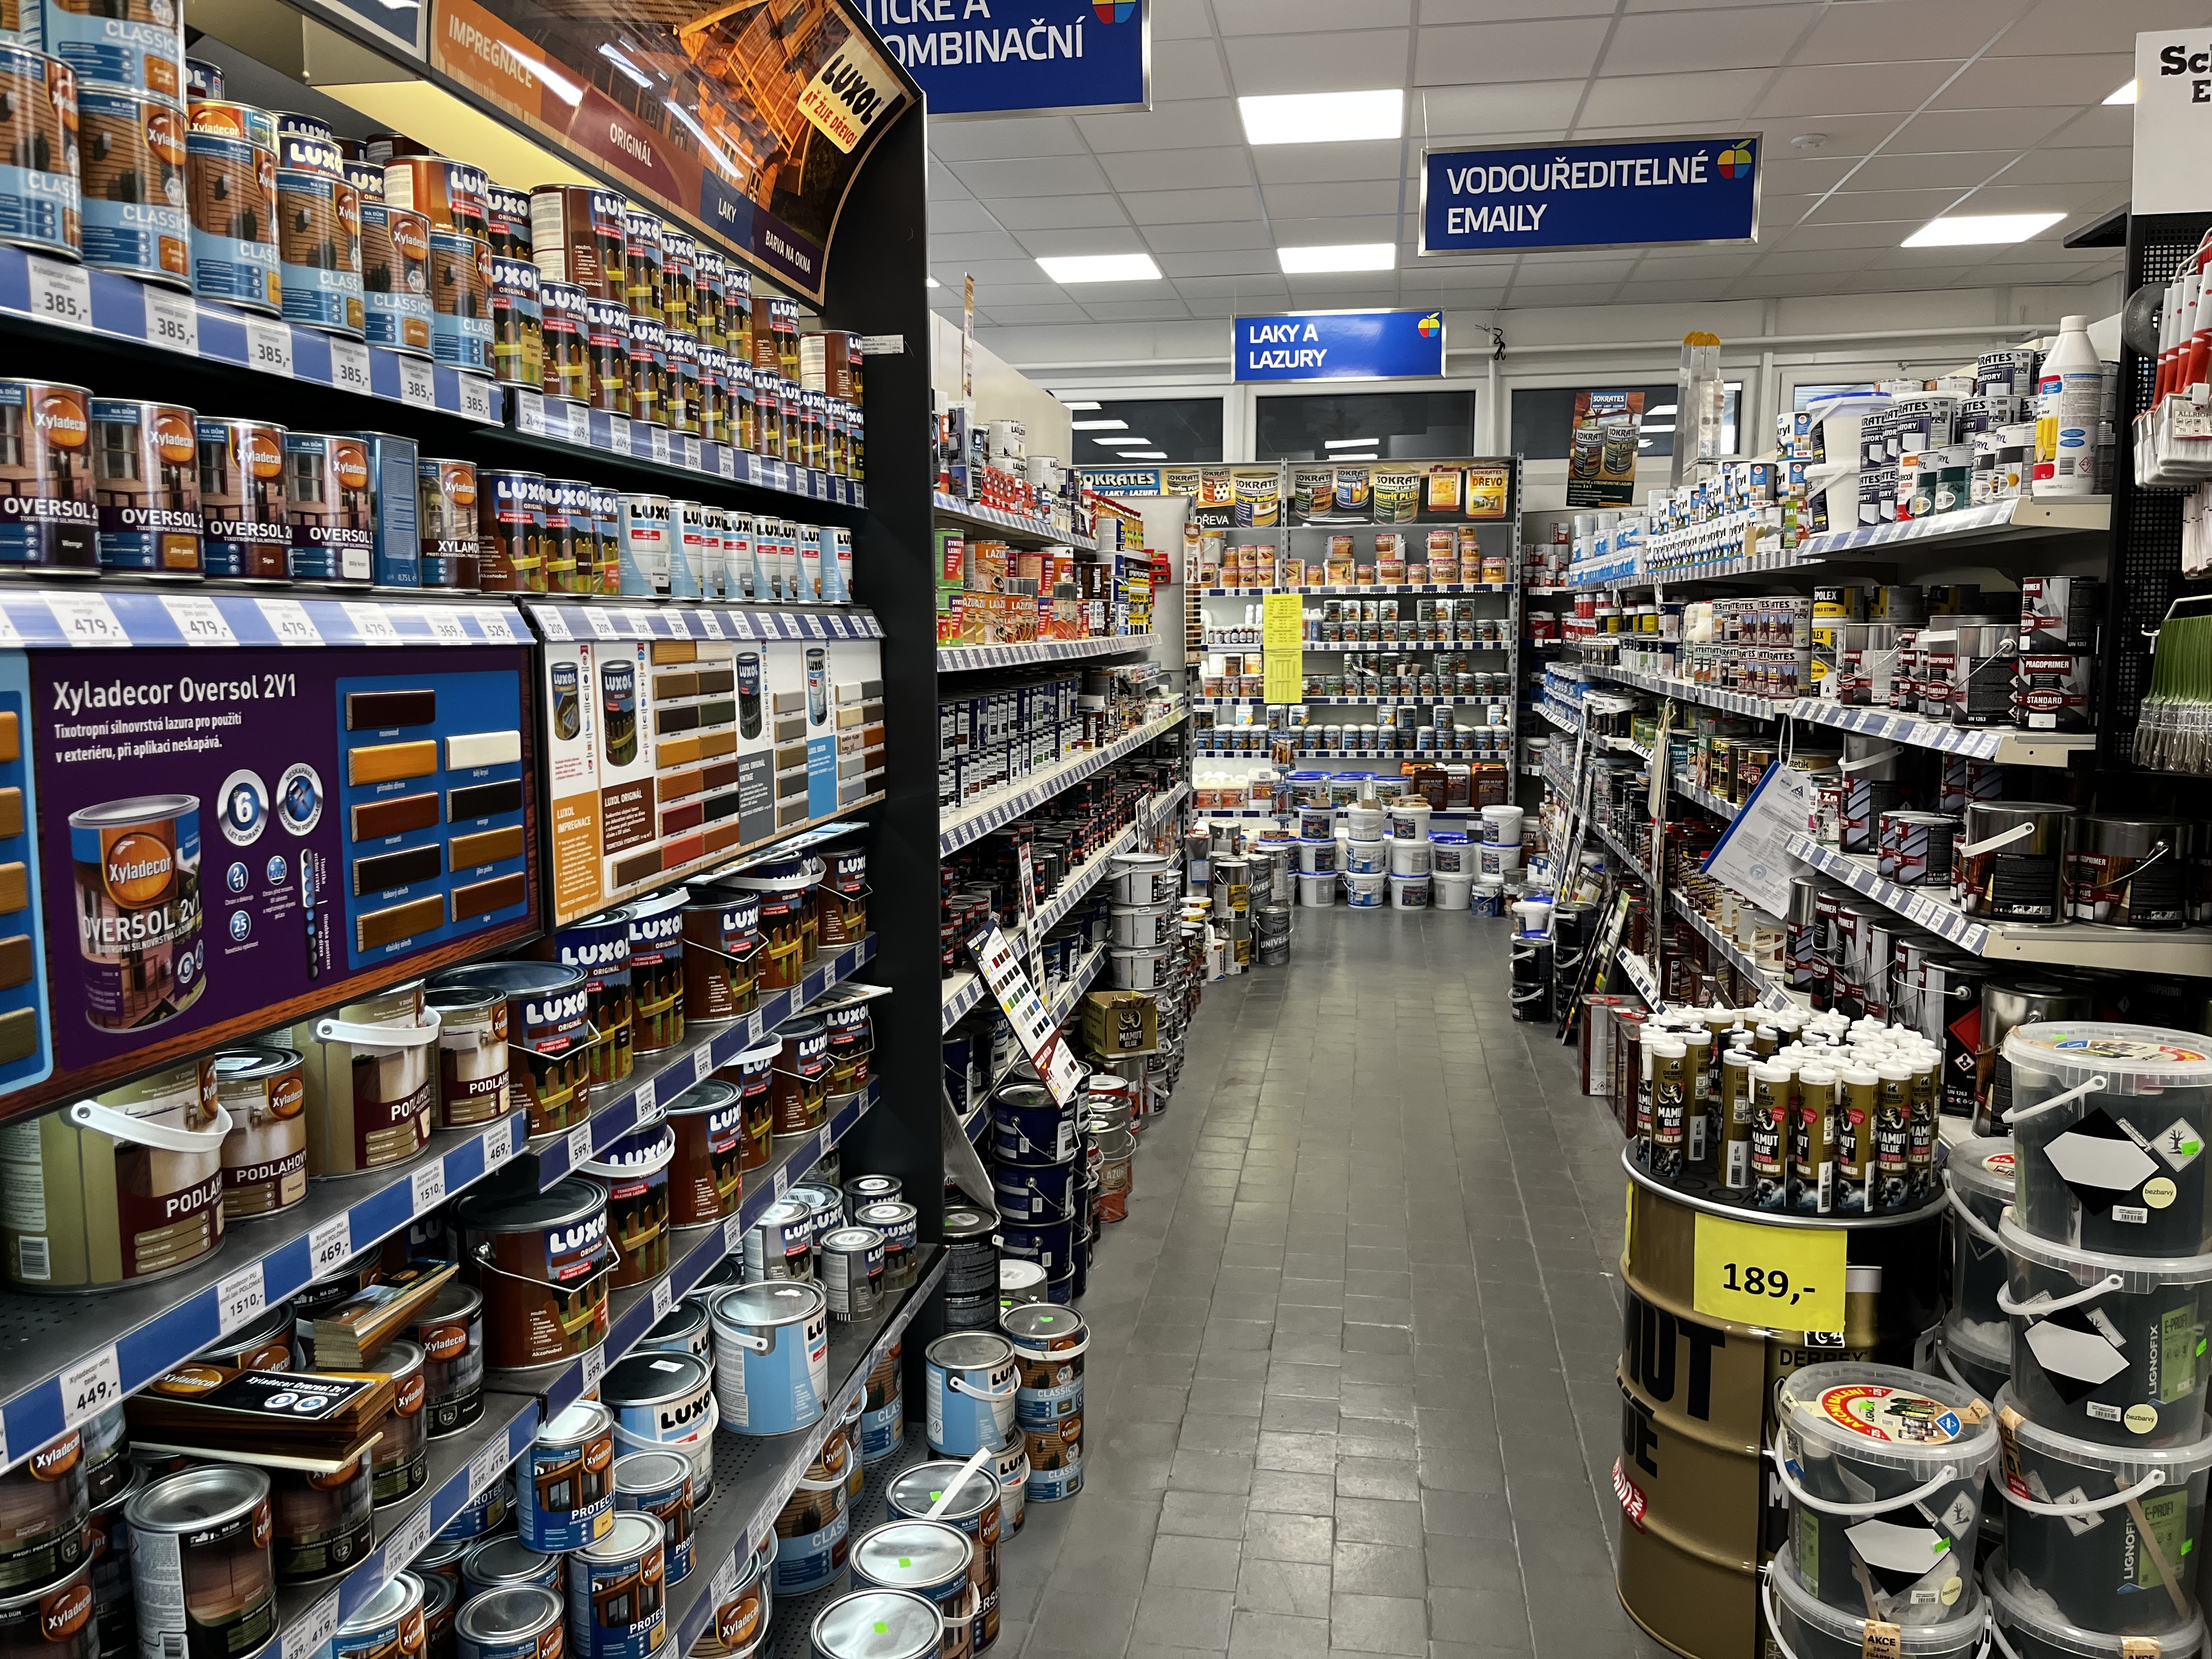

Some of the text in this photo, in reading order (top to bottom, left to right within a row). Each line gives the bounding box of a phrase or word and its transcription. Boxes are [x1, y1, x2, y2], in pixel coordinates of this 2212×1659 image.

[882, 16, 1084, 67] OMBINAČNÍ
[449, 14, 533, 89] IMPREGNACE
[821, 54, 883, 127] LUXOL
[813, 98, 836, 123] ŽIJE
[830, 114, 857, 148] DŘEVO!
[610, 122, 652, 167] ORIGINÁL
[1447, 150, 1708, 195] VODOUŘEDITELNÉ
[718, 196, 737, 224] LAKY
[498, 215, 523, 224] ORIGINÁL
[1447, 204, 1548, 235] EMAILY
[765, 229, 811, 275] BARVA NA OKNA
[499, 287, 527, 297] ORIGINÁL
[44, 291, 88, 317] 385,-
[158, 318, 195, 343] 385,-
[1249, 324, 1318, 344] LAKY A
[258, 344, 291, 367] 385,-
[1249, 349, 1328, 370] LAZURY
[341, 365, 369, 387] 385,-
[408, 381, 433, 402] 385,-
[466, 396, 488, 415] 385,-
[36, 413, 87, 431] Xyladecor
[150, 431, 193, 448] Xyladecor
[1472, 477, 1503, 486] DŘEVO
[1400, 492, 1417, 500] PLUS
[4, 497, 90, 519] OVERSOL
[122, 509, 197, 527] OVERSOL
[1195, 515, 1229, 526] DŘEVA
[211, 521, 284, 540] OVERSOL
[310, 527, 369, 543] OVERSOL
[61, 540, 83, 548] Wenge
[74, 618, 121, 637] 479,-
[189, 620, 232, 638] 479,-
[281, 620, 321, 637] 479,-
[363, 622, 394, 636] 479,-
[438, 624, 465, 639] 369,-
[487, 624, 512, 637] 529,-
[549, 623, 569, 636] 209,-
[739, 665, 758, 678] LUXOL
[808, 659, 824, 672] LUXOL
[554, 673, 575, 685] LUXOL
[605, 674, 633, 691] LUXOL
[53, 674, 297, 714] Xyladecor Oversol 2V1
[54, 712, 242, 741] Tixotropní silnovrstvá lazura pro použití
[64, 746, 116, 762] exteriéru,
[118, 743, 132, 759] při
[133, 740, 171, 757] aplikaci
[172, 735, 222, 755] neskapává.
[235, 792, 253, 822] 6
[604, 788, 642, 808] LUXOL ORIGINÁL
[557, 806, 575, 820] LUXOL
[557, 815, 591, 834] IMPREGNACE
[110, 856, 172, 884] Xyladecor
[235, 919, 246, 932] 25
[656, 939, 677, 949] ORIGINÁL
[1260, 935, 1289, 949] UNIVER
[593, 965, 620, 976] ORIGINÁL
[558, 1018, 582, 1032] ORIGINÁL
[1119, 1030, 1142, 1041] MAMUT
[1664, 1118, 1680, 1126] GLUE
[490, 1144, 511, 1159] 469,-
[574, 1141, 591, 1159] 599,-
[1881, 1144, 1899, 1153] GLUE
[421, 1183, 445, 1201] 1510,-
[421, 1183, 443, 1201] 1510,-
[2145, 1187, 2174, 1197] bezbarvý
[320, 1242, 348, 1263] 469,-
[580, 1240, 602, 1257] ORIGINÁL
[1723, 1262, 1816, 1305] 189,-
[230, 1293, 263, 1316] 1510,-
[658, 1295, 671, 1313] 599,-
[424, 1333, 466, 1352] Xyladecor
[532, 1346, 562, 1358] AkzoNobel
[2148, 1323, 2158, 1396] LIGNOFIX
[588, 1361, 604, 1381] 599,-
[77, 1380, 117, 1410] 449,-
[442, 1413, 454, 1421] 12
[2126, 1412, 2155, 1424] bezbarvý
[489, 1455, 508, 1473] 419,-
[2145, 1501, 2174, 1520] E-PROFI
[65, 1544, 77, 1557] 12
[336, 1545, 348, 1558] 12
[312, 1622, 337, 1644] 419,-
[1867, 1634, 1895, 1647] AKCE
